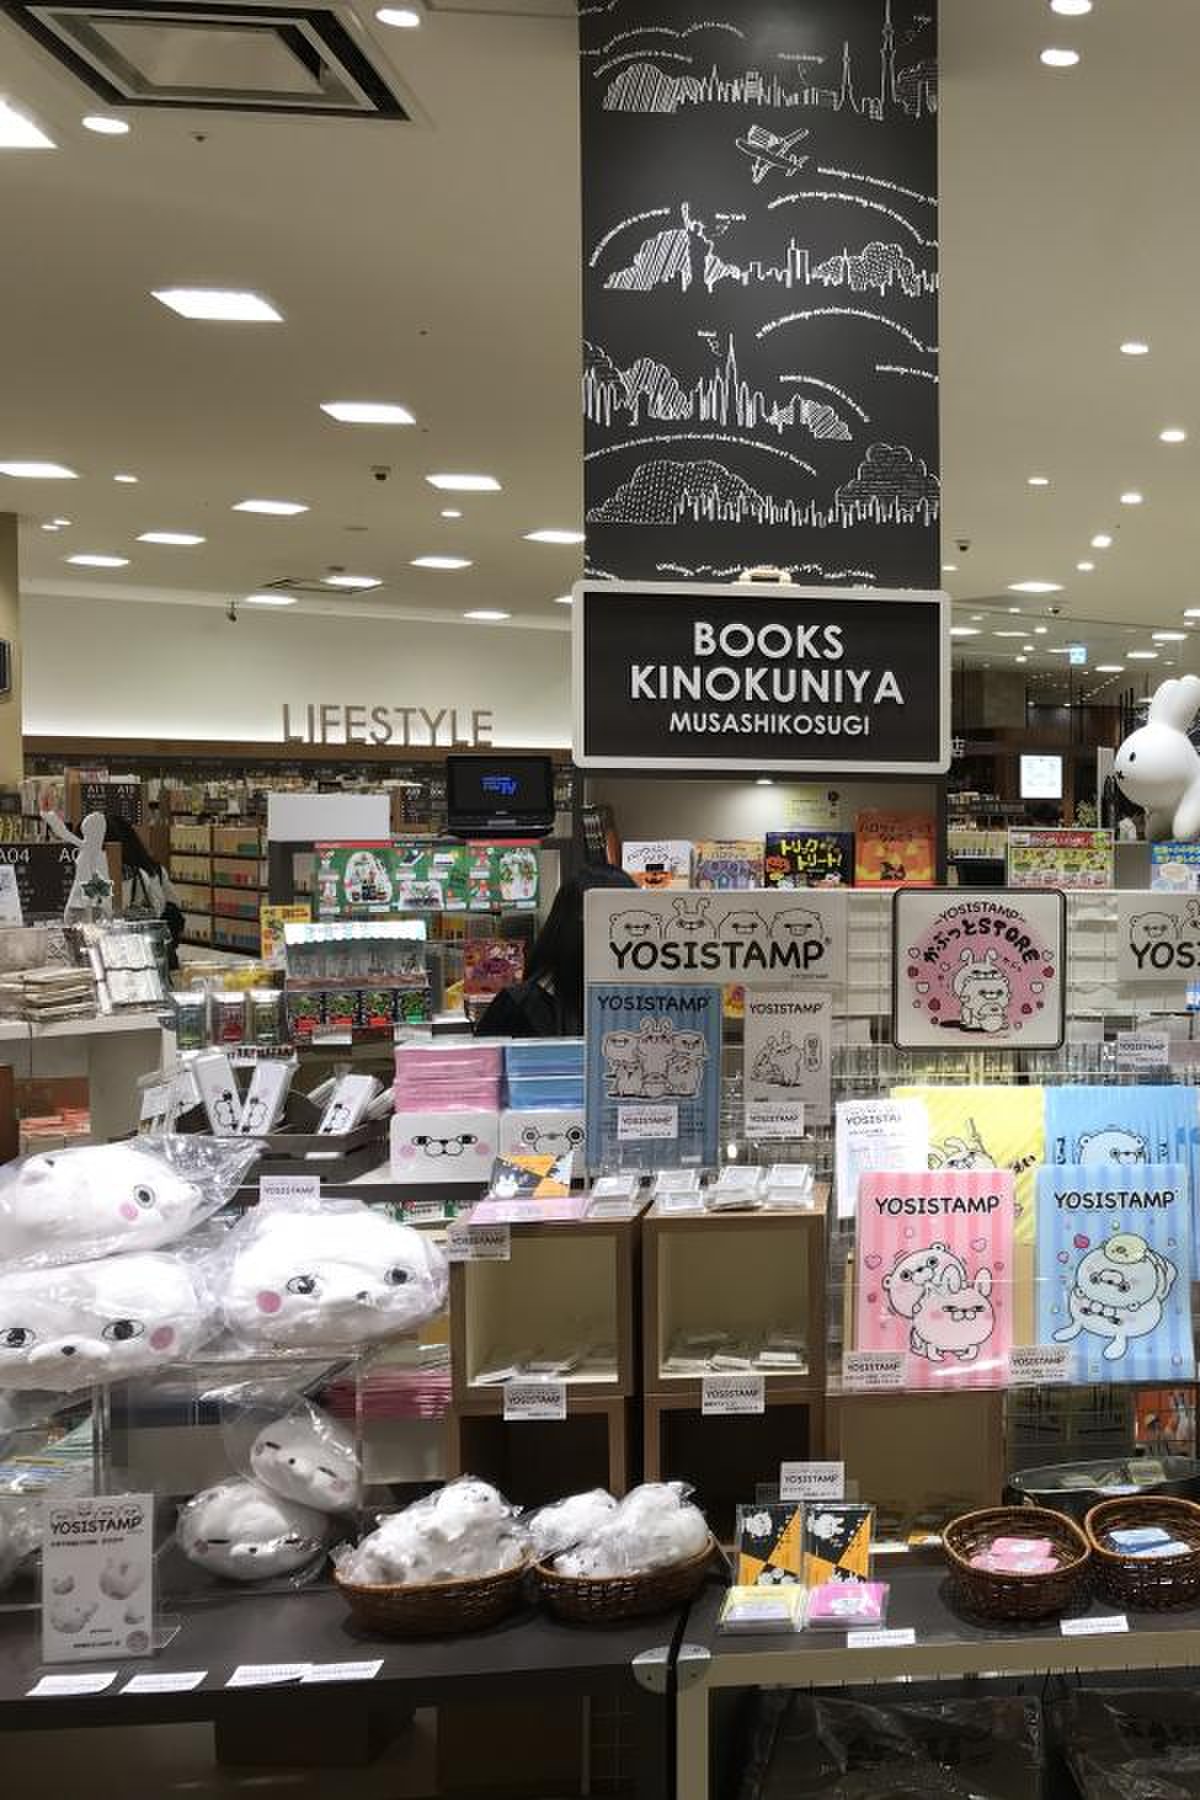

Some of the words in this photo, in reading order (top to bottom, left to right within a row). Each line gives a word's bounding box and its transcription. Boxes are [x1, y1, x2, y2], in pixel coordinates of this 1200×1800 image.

[693, 621, 845, 660] BOOKS
[630, 664, 905, 706] KINOKUNIYA
[282, 703, 494, 747] LIFESTYLE
[669, 711, 871, 737] MUSASHIKOSUGI
[608, 939, 826, 971] YOSISTAMP
[597, 995, 710, 1014] YOSISTAMP
[750, 1002, 822, 1016] YOSISTAMP
[875, 1195, 1001, 1216] YOSISTAMP
[1054, 1190, 1176, 1211] YOSISTAMP
[50, 1517, 143, 1536] YOSISTAMP
